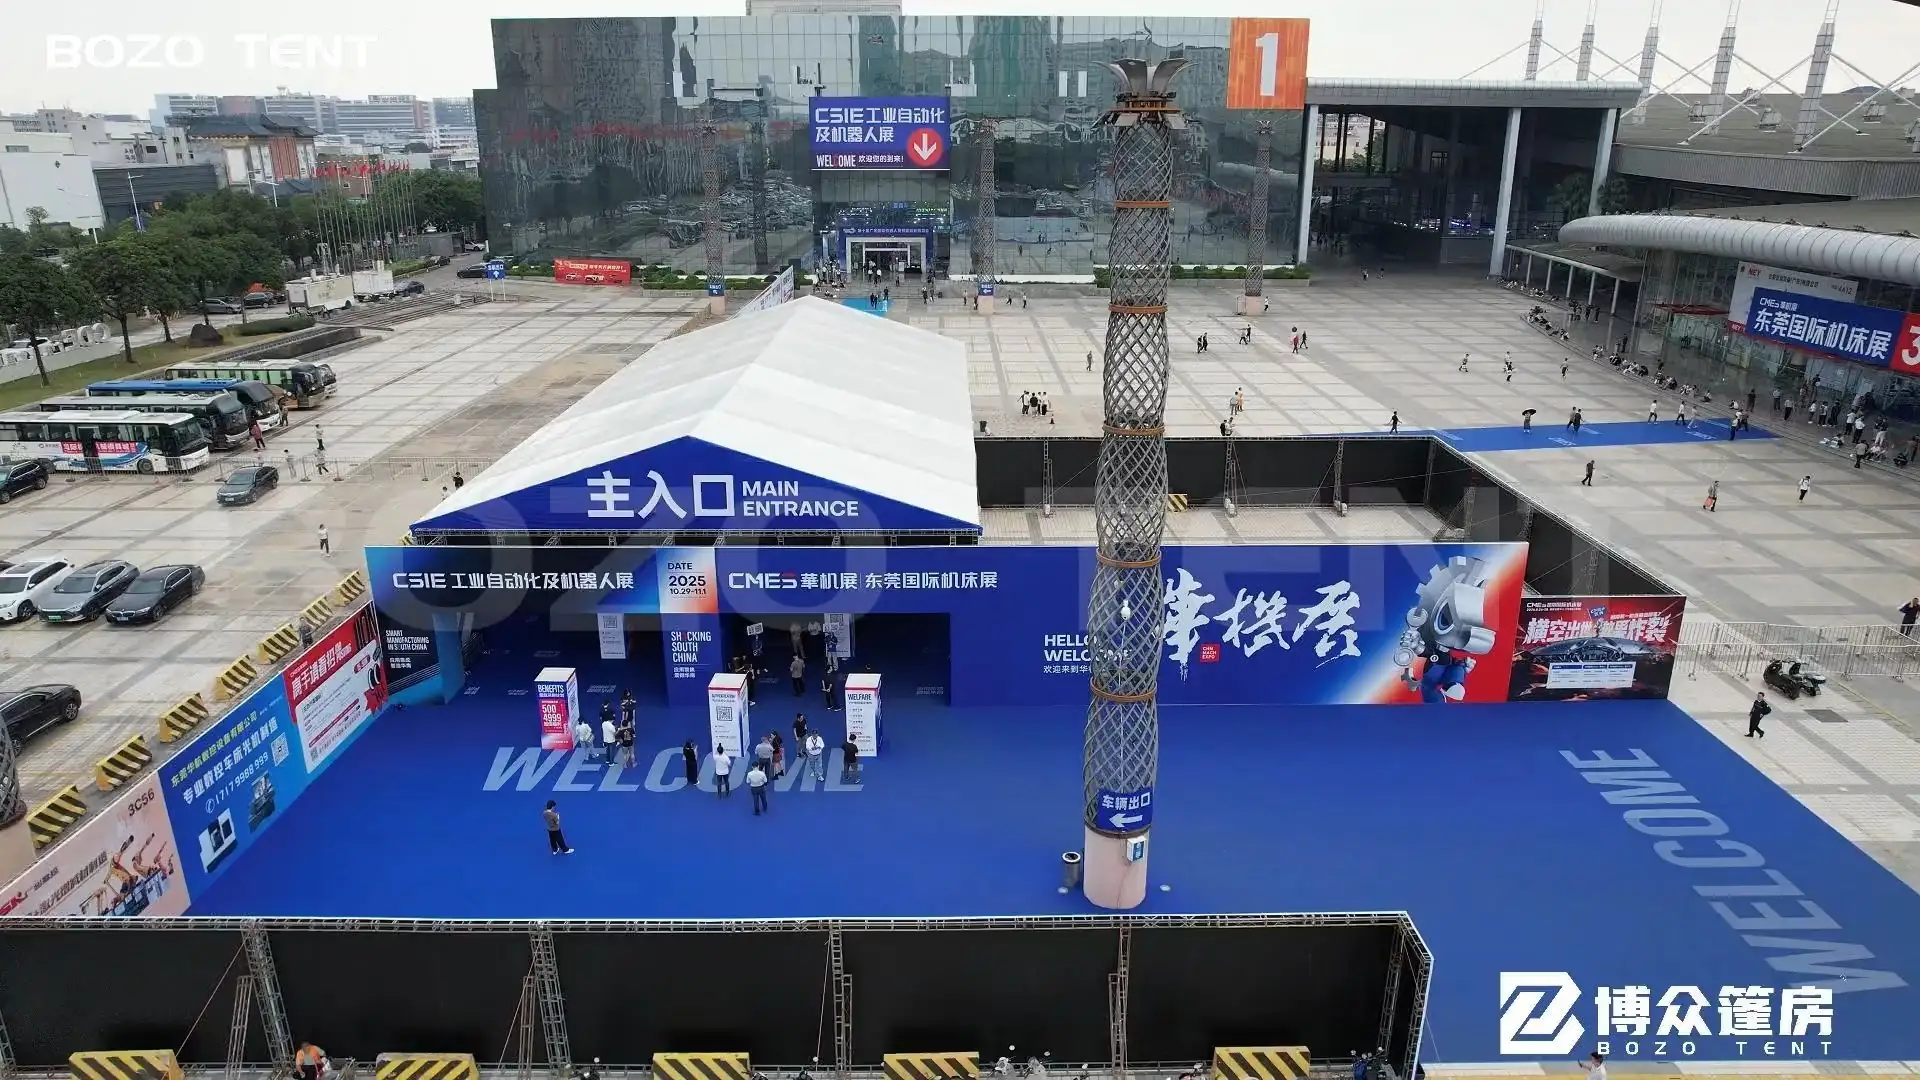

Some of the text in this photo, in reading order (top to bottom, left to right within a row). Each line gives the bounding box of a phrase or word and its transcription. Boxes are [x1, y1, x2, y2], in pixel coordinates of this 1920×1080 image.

[1255, 32, 1279, 97] 1
[815, 126, 895, 143] 及机器人展
[816, 154, 857, 168] WELCOME
[1753, 308, 1893, 360] 东莞国际机床展
[586, 470, 735, 519] 主入口
[742, 480, 799, 497] MAIN
[743, 500, 859, 517] ENTRANCE
[667, 562, 693, 570] DATE
[392, 572, 635, 590] CSIE 工业自动化及机器人展
[668, 575, 706, 587] 2025
[728, 572, 798, 589] CMES
[865, 571, 998, 590] 东莞国际机床展
[385, 629, 403, 637] SMART
[386, 636, 430, 644] MANUFACTURING
[387, 643, 394, 651] IN
[411, 643, 428, 651] CHINA
[671, 642, 699, 652] SOUTH
[672, 652, 698, 663] CHINA
[537, 684, 565, 693] BENEFITS
[541, 704, 557, 713] 500
[543, 713, 562, 722] 4999
[127, 787, 156, 818] 3C56
[1101, 791, 1151, 811] 车辆出口
[1558, 748, 1910, 995] WELCOME
